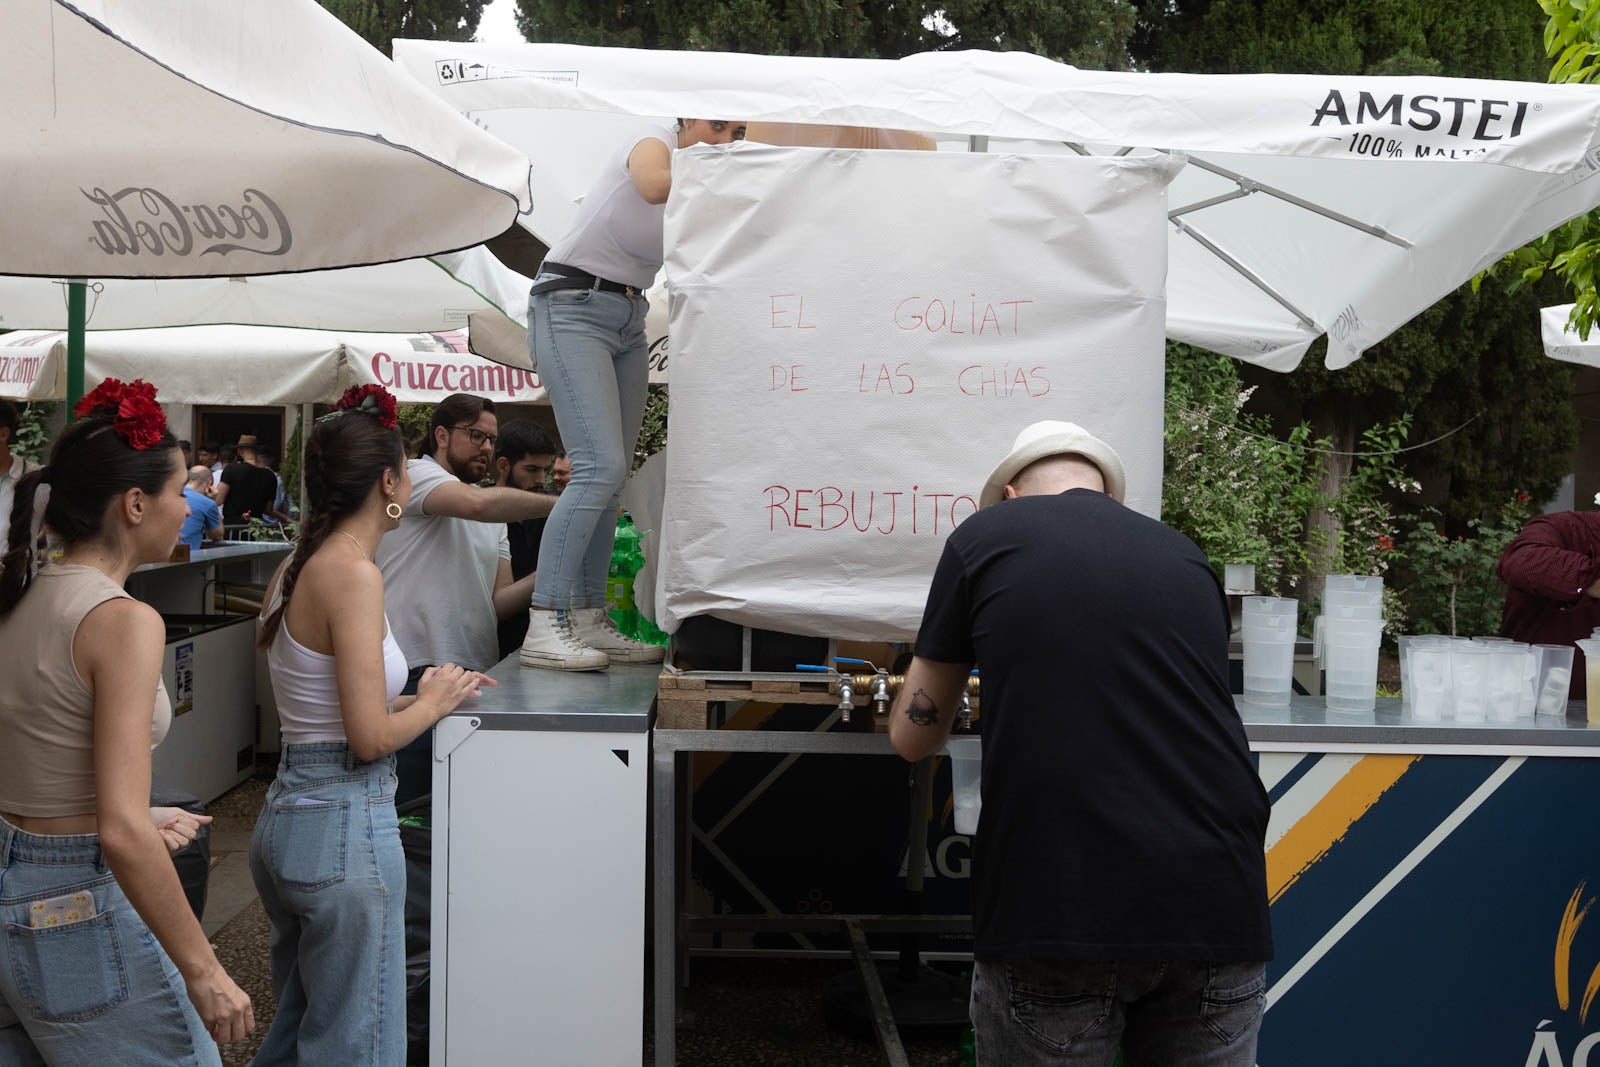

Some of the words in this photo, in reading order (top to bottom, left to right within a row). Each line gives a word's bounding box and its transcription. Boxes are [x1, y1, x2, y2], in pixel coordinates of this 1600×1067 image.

[1348, 132, 1402, 158] 100%
[769, 294, 817, 329] EL
[768, 364, 809, 392] DE
[859, 363, 915, 395] LAS
